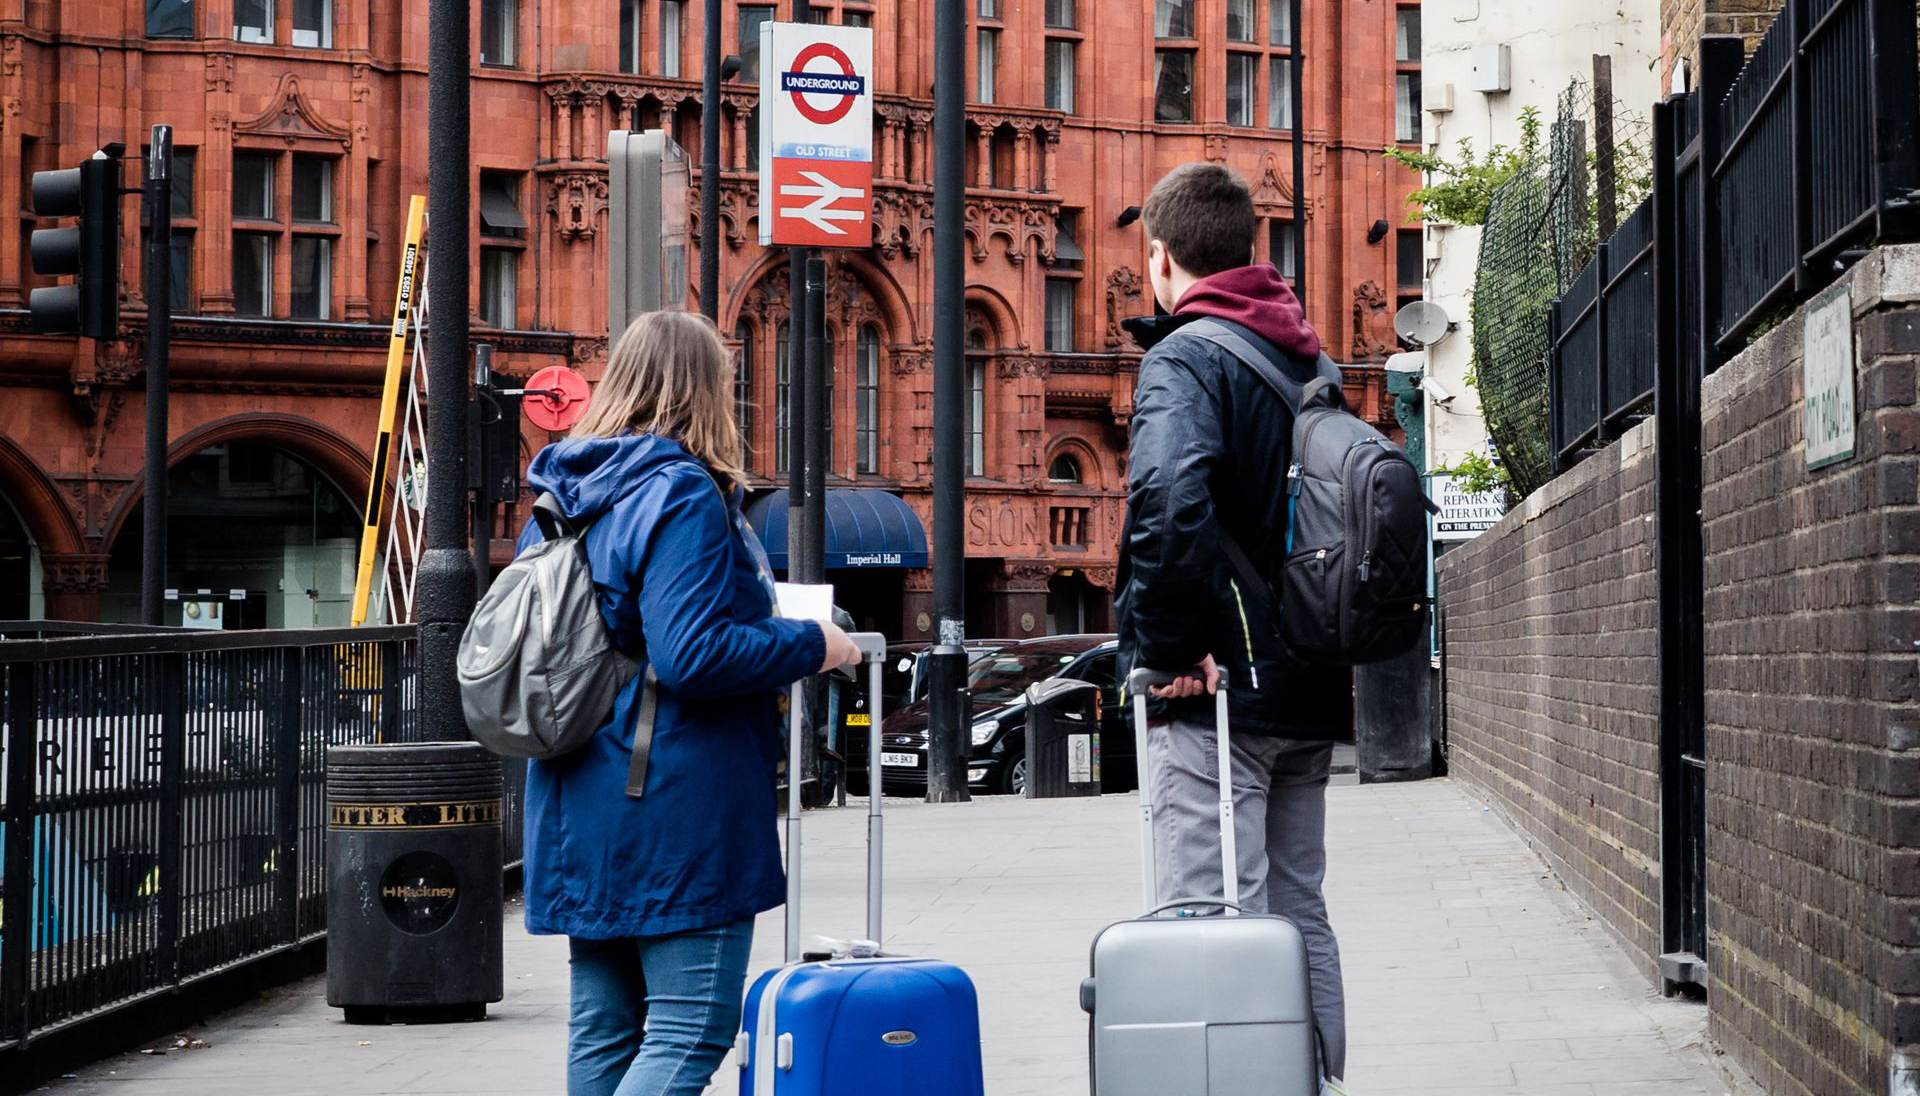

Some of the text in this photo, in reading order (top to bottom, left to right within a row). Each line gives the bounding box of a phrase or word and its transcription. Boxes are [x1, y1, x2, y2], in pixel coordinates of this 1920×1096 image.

[786, 77, 860, 91] UNDERGROUND
[795, 146, 850, 158] OLD STREET
[1444, 494, 1488, 506] REPAIRS
[1441, 522, 1452, 531] ON
[1453, 522, 1469, 530] THE
[846, 553, 901, 567] Imperial Hall
[329, 805, 407, 826] LITTER
[397, 885, 456, 899] Hackney
